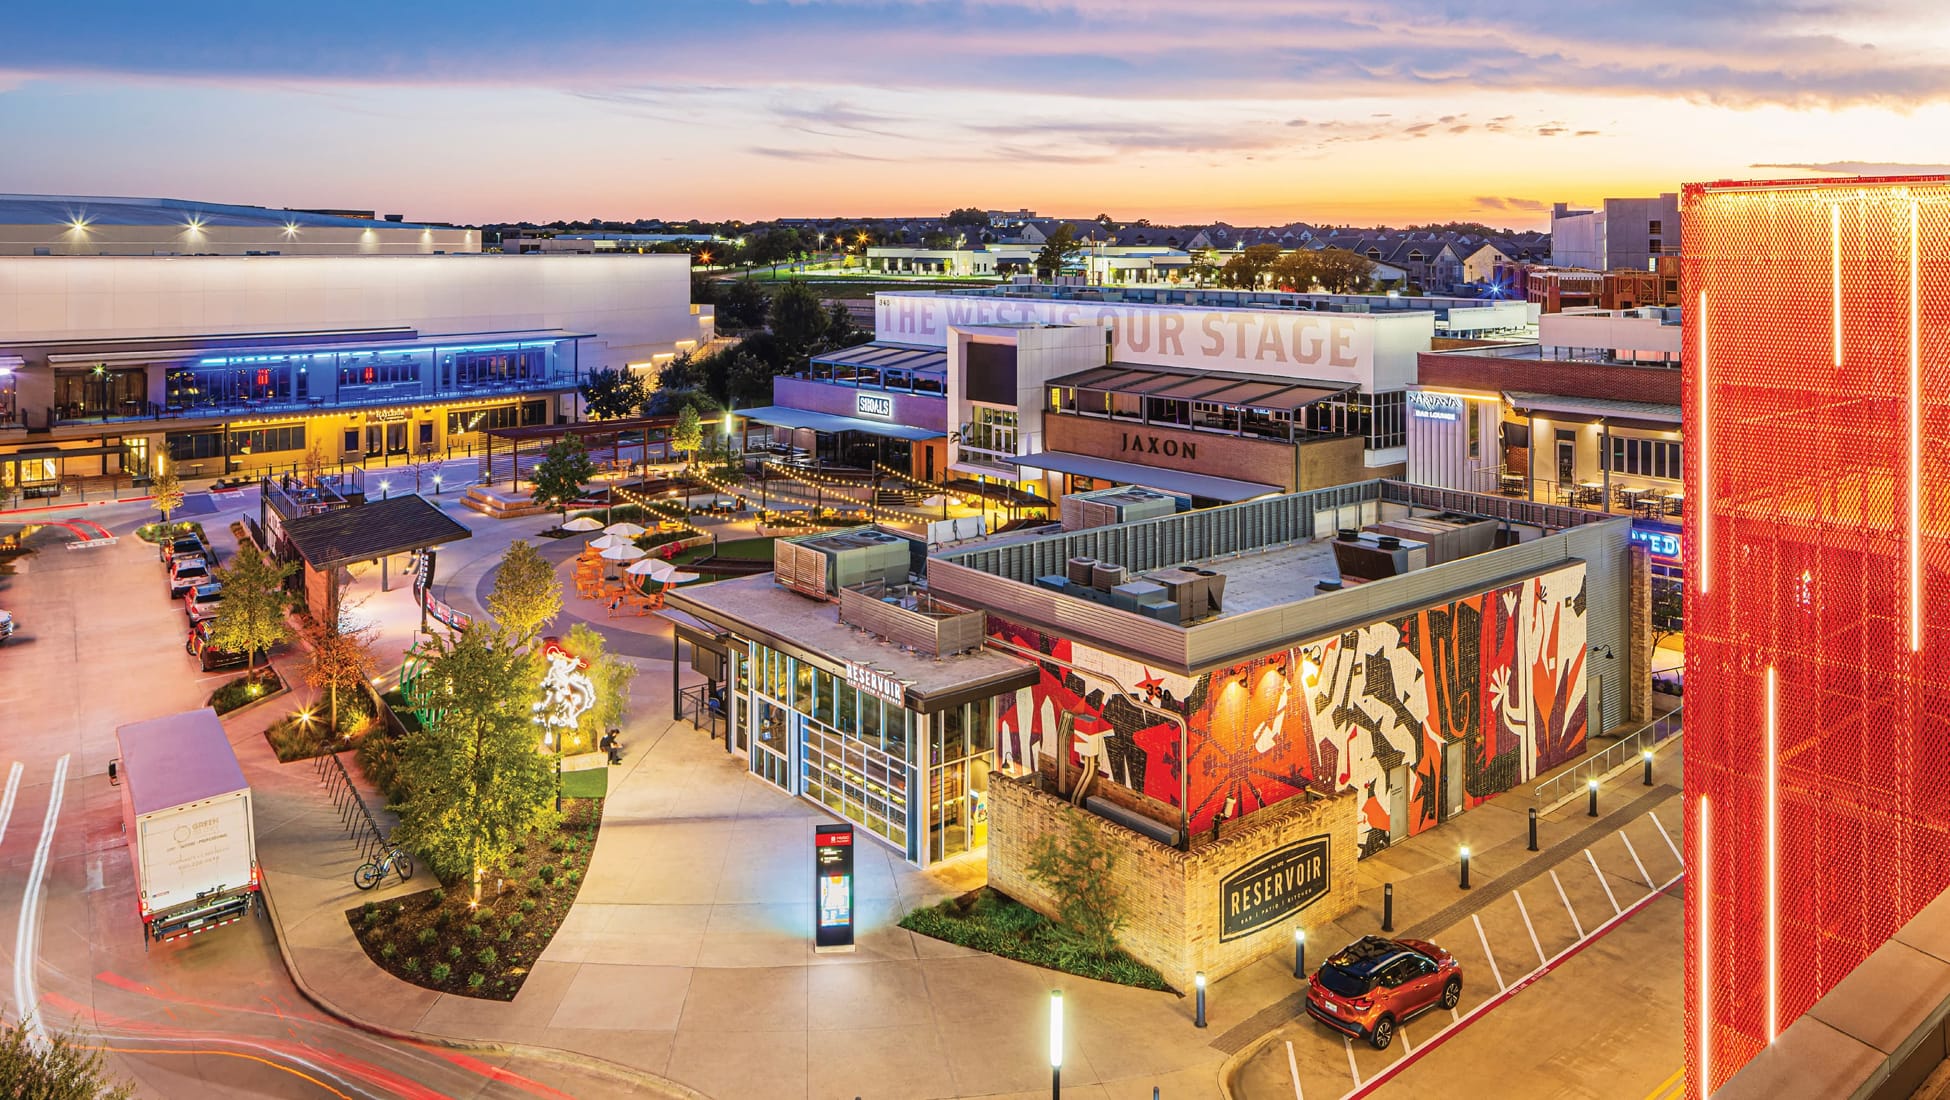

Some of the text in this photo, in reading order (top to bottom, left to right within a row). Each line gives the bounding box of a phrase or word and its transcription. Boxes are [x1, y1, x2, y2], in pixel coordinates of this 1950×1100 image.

[882, 297, 936, 335] THE
[1097, 308, 1184, 356] OUR
[1200, 312, 1358, 368] STAGE
[1121, 432, 1197, 460] JAXON
[846, 663, 901, 701] RESERVOIR
[1146, 683, 1171, 702] 330
[1231, 856, 1321, 917] RESERVOIR
[1240, 888, 1312, 925] BAR PATIO KITCHEN
